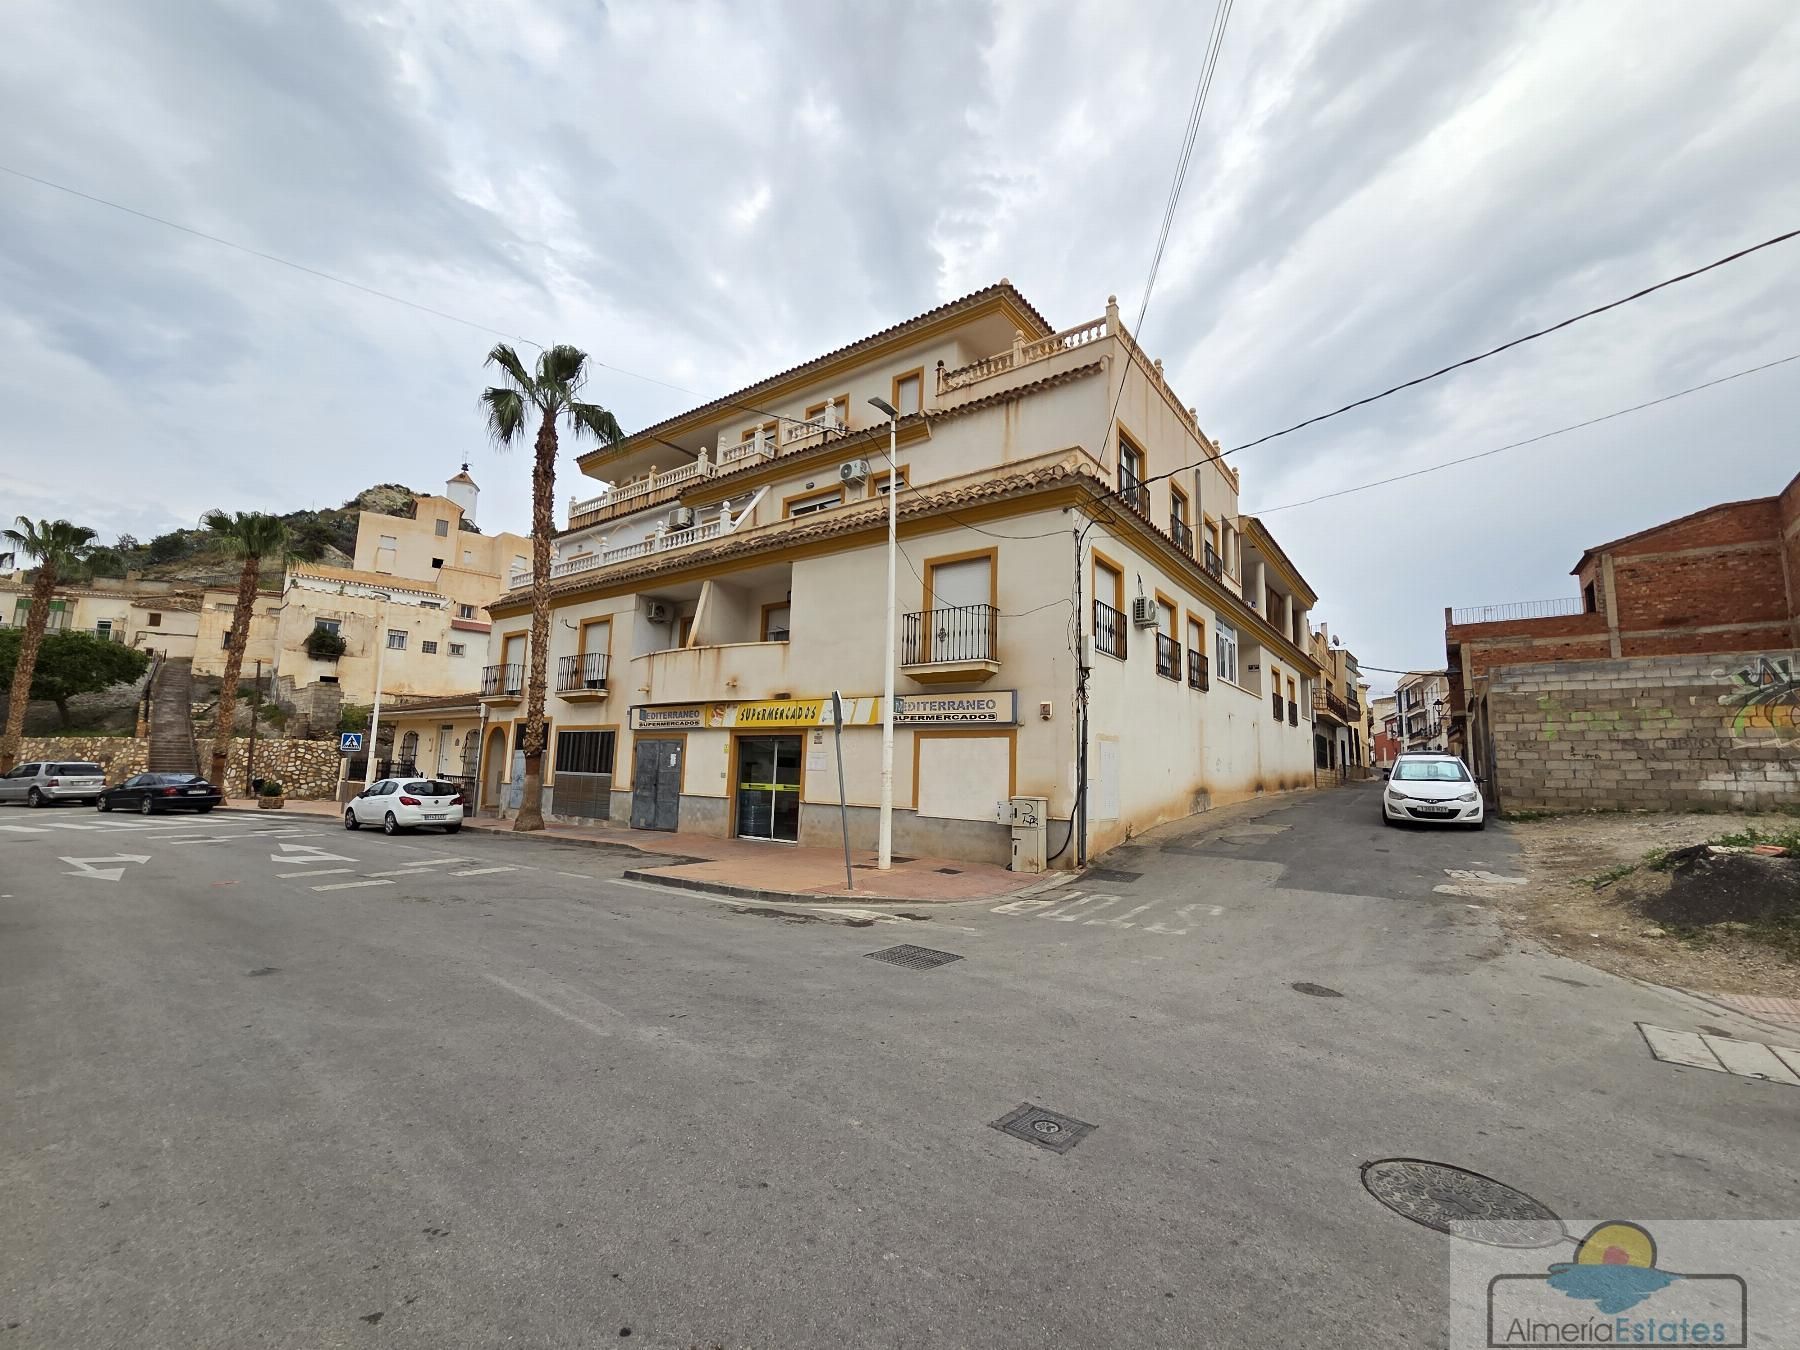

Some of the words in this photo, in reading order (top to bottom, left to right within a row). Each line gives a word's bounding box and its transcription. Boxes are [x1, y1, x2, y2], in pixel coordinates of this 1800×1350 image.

[894, 699, 996, 713] MEDITERRANEO
[740, 706, 816, 721] SUPERMERCADOS
[893, 713, 996, 721] SUPERMERCADOS
